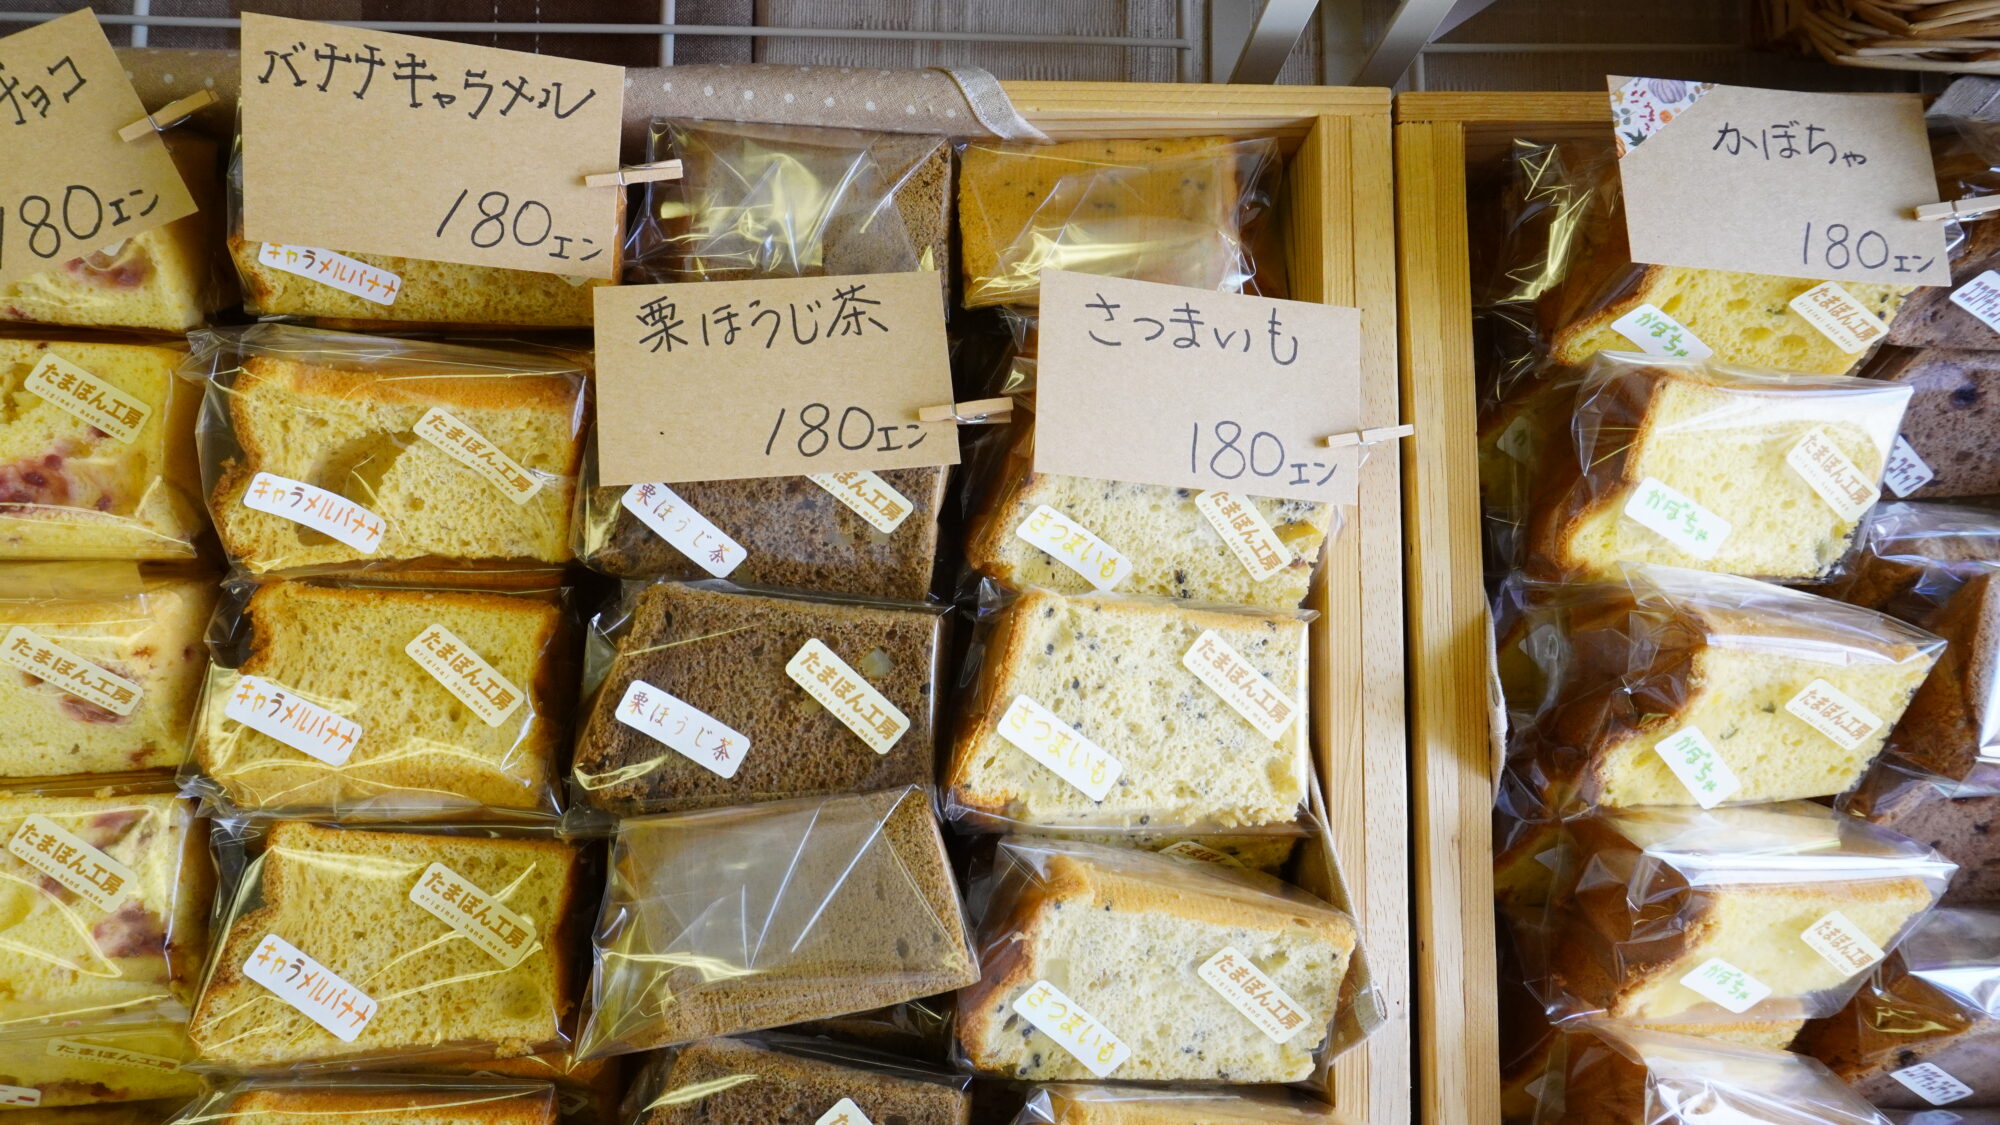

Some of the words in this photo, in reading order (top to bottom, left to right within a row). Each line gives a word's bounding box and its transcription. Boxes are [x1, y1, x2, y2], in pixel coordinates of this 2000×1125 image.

[258, 43, 597, 120] バナナキャラメル
[1712, 119, 1867, 168] かぼちゃ
[436, 189, 604, 263] 180エン
[1802, 221, 1935, 275] 180エン
[636, 284, 889, 353] 栗ほうじ茶
[1085, 293, 1299, 366] さつまいも
[38, 363, 145, 429] たまぽん工房
[765, 402, 928, 458] 180エン
[426, 414, 534, 493] たまぽん工房
[1191, 420, 1338, 487] 180エン
[832, 472, 906, 521] ぽん工房
[1028, 511, 1118, 578] さつまいも
[11, 637, 136, 705] たまぽん工房
[421, 632, 516, 711] たまぽん工房
[800, 651, 901, 740] たまぽん工房
[1197, 639, 1292, 723] たまぽん工房
[626, 691, 733, 761] 栗ほうじ茶
[1010, 704, 1106, 784] さつまいも
[18, 824, 125, 896] たまぽん工房
[424, 872, 529, 950] たまぽん工房
[1027, 986, 1116, 1063] さつまいも
[1214, 954, 1304, 1030] たまぽん工房
